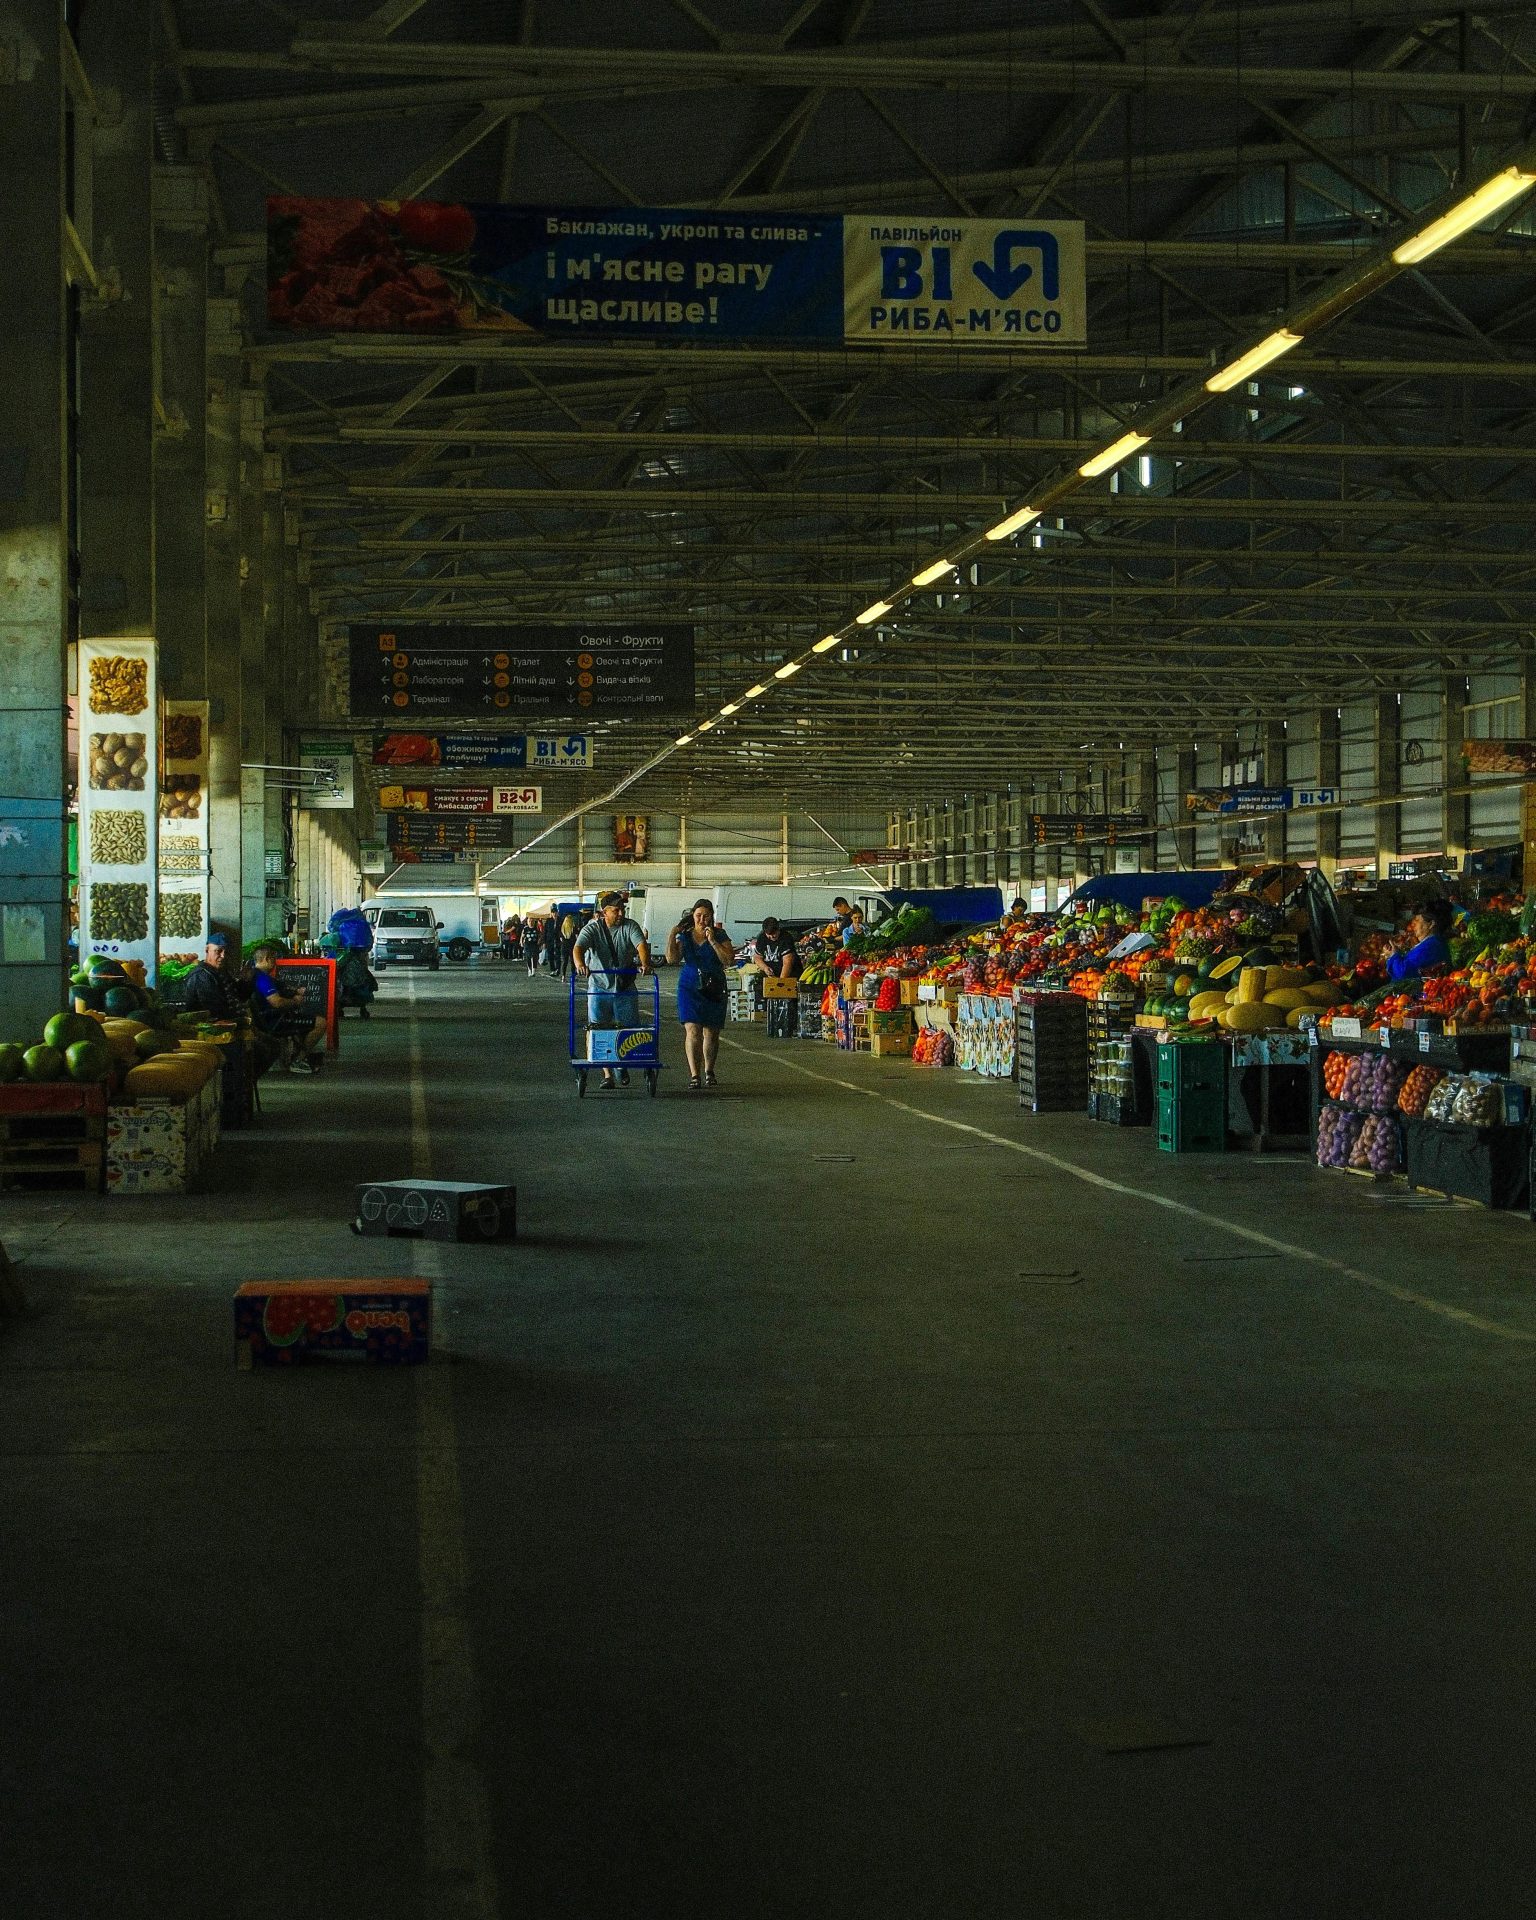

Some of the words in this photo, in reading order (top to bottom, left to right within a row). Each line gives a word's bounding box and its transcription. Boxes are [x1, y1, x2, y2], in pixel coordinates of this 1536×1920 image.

[546, 217, 655, 242] Баклажан,
[659, 223, 719, 243] укроп
[723, 226, 747, 240] та
[751, 227, 808, 242] слива
[870, 226, 962, 242] ПАВІЛЬЙОН
[546, 253, 556, 282] і
[565, 253, 688, 285] м'ясне
[695, 261, 773, 292] рагу
[546, 295, 718, 329] щасливе!
[870, 306, 1062, 333] РИБА-М'ЯСО
[580, 635, 612, 646] Овочі
[622, 635, 664, 648] Фрукти
[513, 657, 540, 667] Туалет
